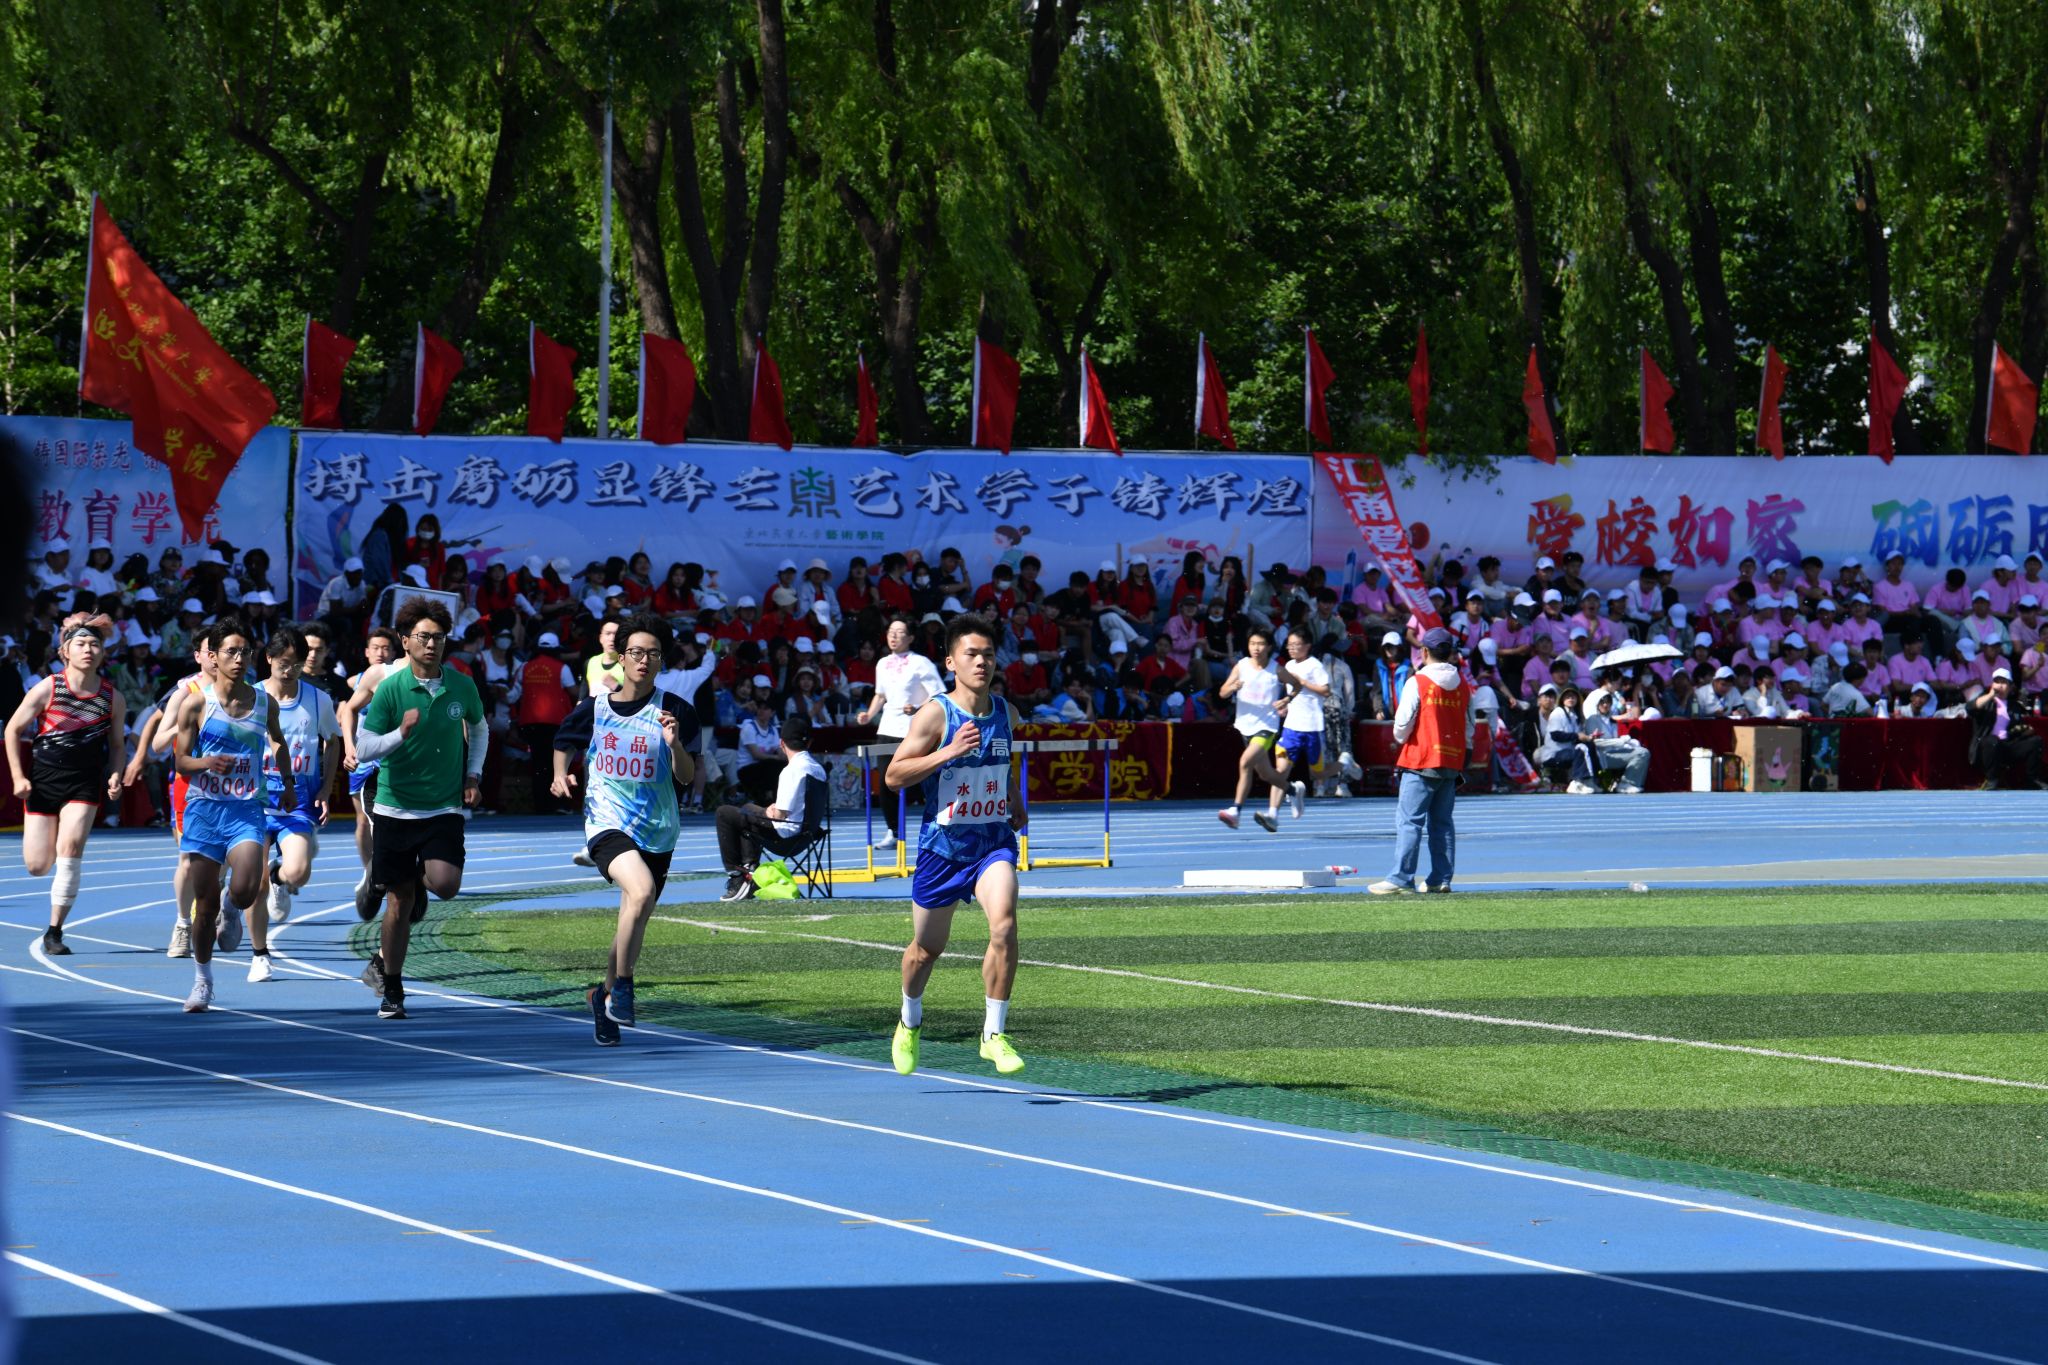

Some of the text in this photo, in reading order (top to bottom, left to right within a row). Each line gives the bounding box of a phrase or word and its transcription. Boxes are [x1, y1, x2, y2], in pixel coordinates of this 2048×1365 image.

[302, 451, 782, 512] 搏击磨砺显锋芒
[848, 465, 1308, 520] 艺术学子铸辉煌
[1526, 493, 1806, 569] 爱校如家
[601, 731, 648, 754] 食品
[596, 754, 654, 779] 08005
[199, 773, 256, 797] 08004
[956, 780, 998, 797] 水利
[946, 798, 1006, 819] 14009
